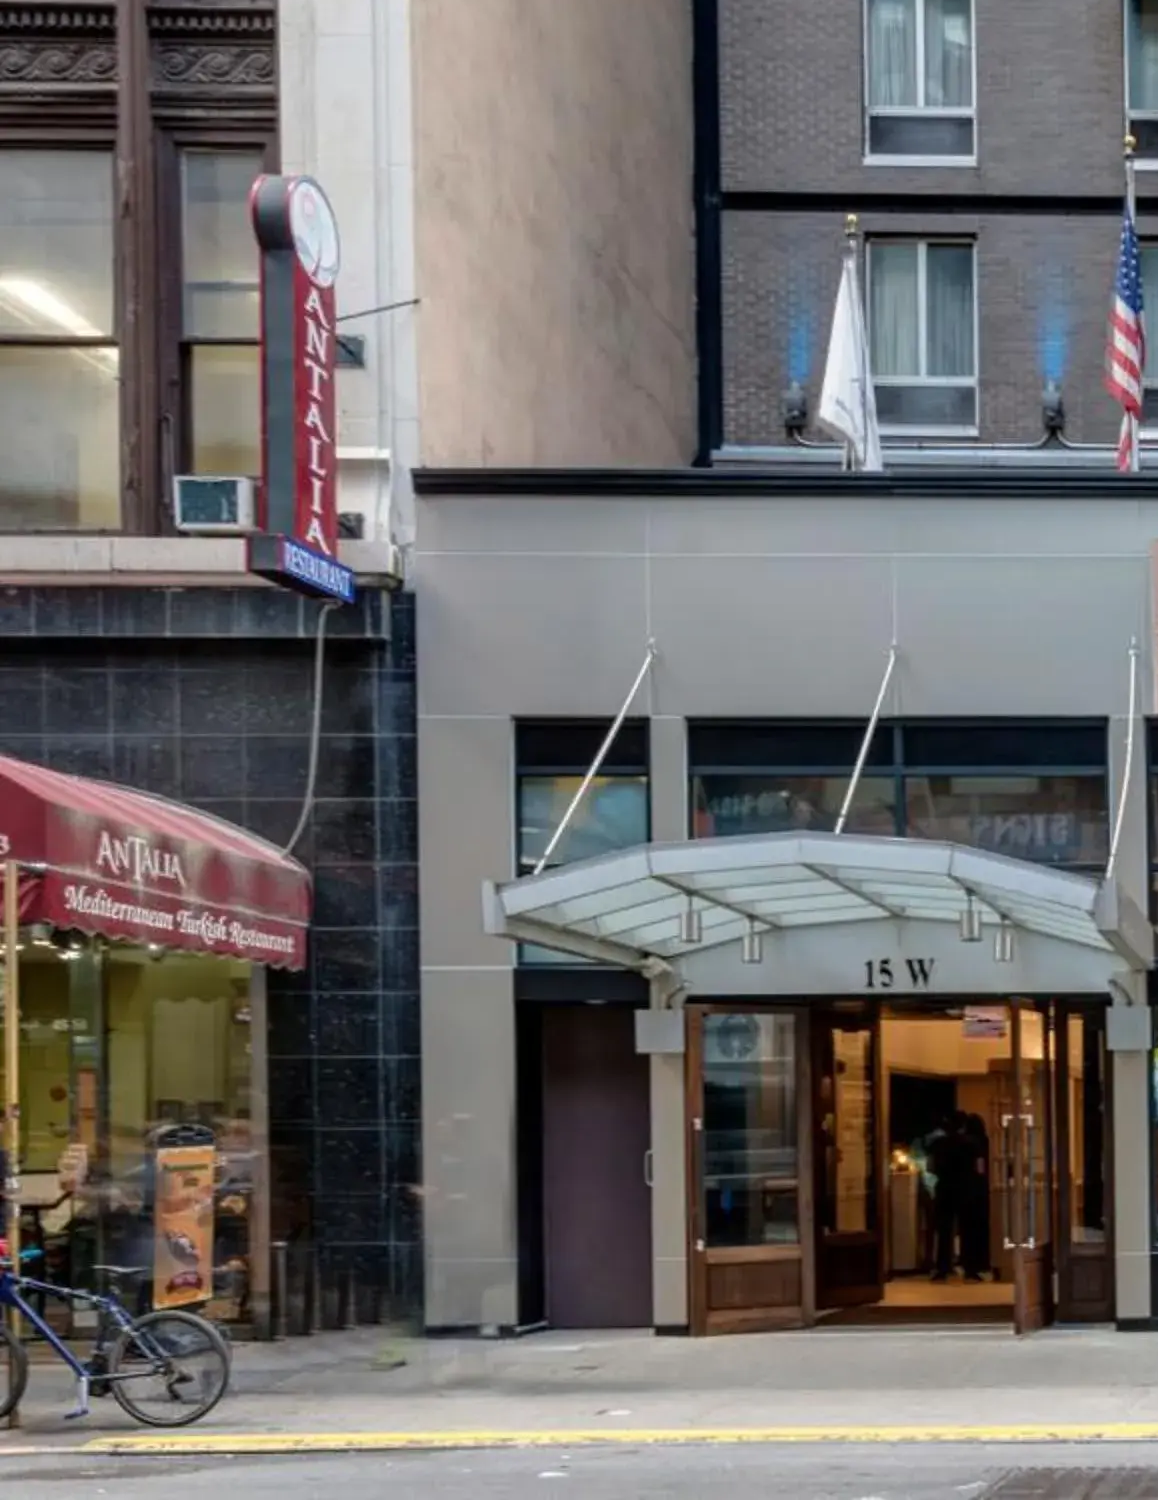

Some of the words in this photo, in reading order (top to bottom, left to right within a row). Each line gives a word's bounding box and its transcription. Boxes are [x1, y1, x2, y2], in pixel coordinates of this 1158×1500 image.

[305, 287, 330, 556] ANTALIA
[284, 541, 351, 597] RESTAURANT
[64, 885, 174, 931] Mediterranean
[177, 908, 228, 945] Turkish
[228, 919, 296, 953] Restaurant
[865, 959, 893, 987] 15
[905, 958, 935, 987] W
